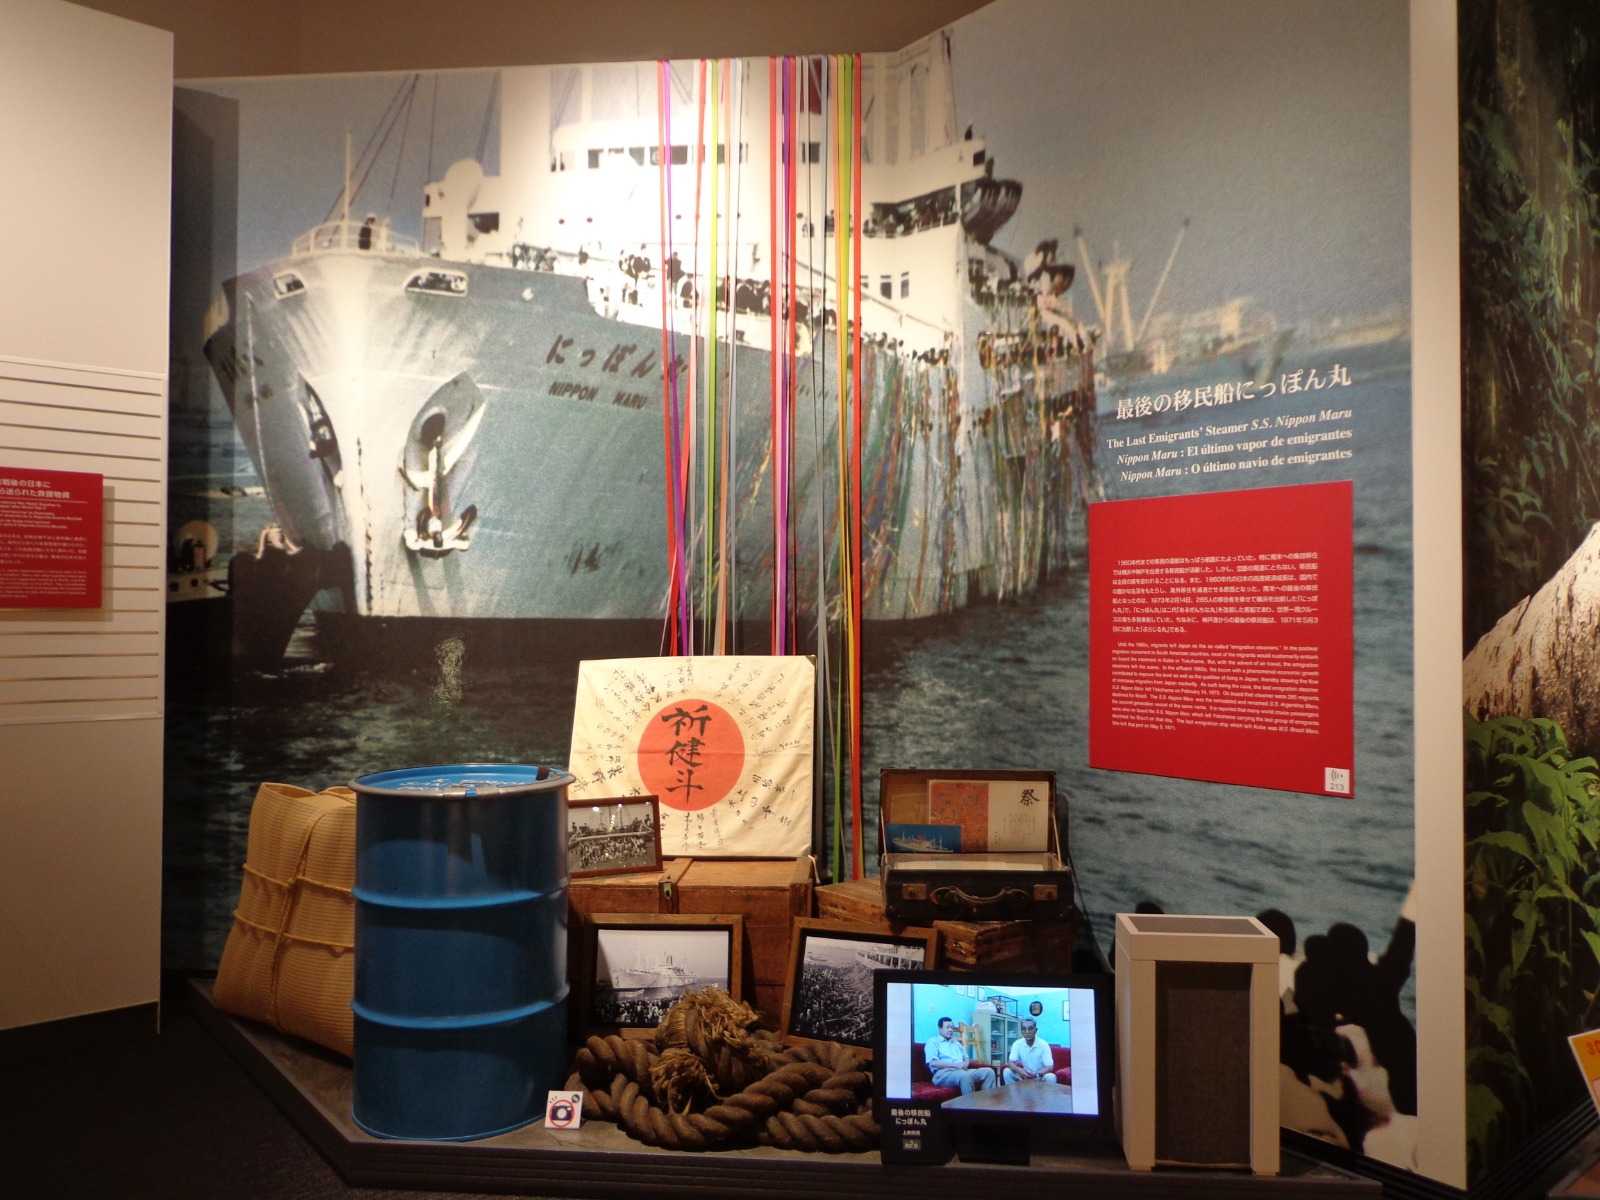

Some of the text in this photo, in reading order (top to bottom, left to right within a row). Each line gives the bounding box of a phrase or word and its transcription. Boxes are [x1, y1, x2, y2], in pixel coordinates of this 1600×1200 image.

[612, 391, 649, 410] MARU
[1115, 363, 1352, 420] 最後の移民船にっぽん丸
[1107, 438, 1124, 448] The
[1126, 436, 1146, 447] Last
[1205, 423, 1248, 436] Steamer
[1251, 418, 1272, 431] S.S.
[1276, 413, 1316, 429] Nippon
[1319, 408, 1352, 422] Maru
[1116, 453, 1150, 465] Nippon
[1151, 449, 1178, 461] Maru
[1187, 446, 1198, 457] El
[1201, 440, 1234, 455] último
[1236, 439, 1268, 453] vapor
[1270, 434, 1284, 447] de
[1287, 428, 1352, 446] emigrantes
[1120, 470, 1153, 482] Nippon
[1155, 467, 1182, 479] Maru
[1191, 464, 1200, 474] O
[1202, 458, 1236, 473] último
[1238, 456, 1269, 469] navio
[1271, 453, 1284, 466] de
[1287, 448, 1352, 466] emigrantes
[0, 478, 51, 488] 戦後の日本に
[1019, 788, 1040, 806] 祭
[891, 1109, 931, 1117] 最後の移民船
